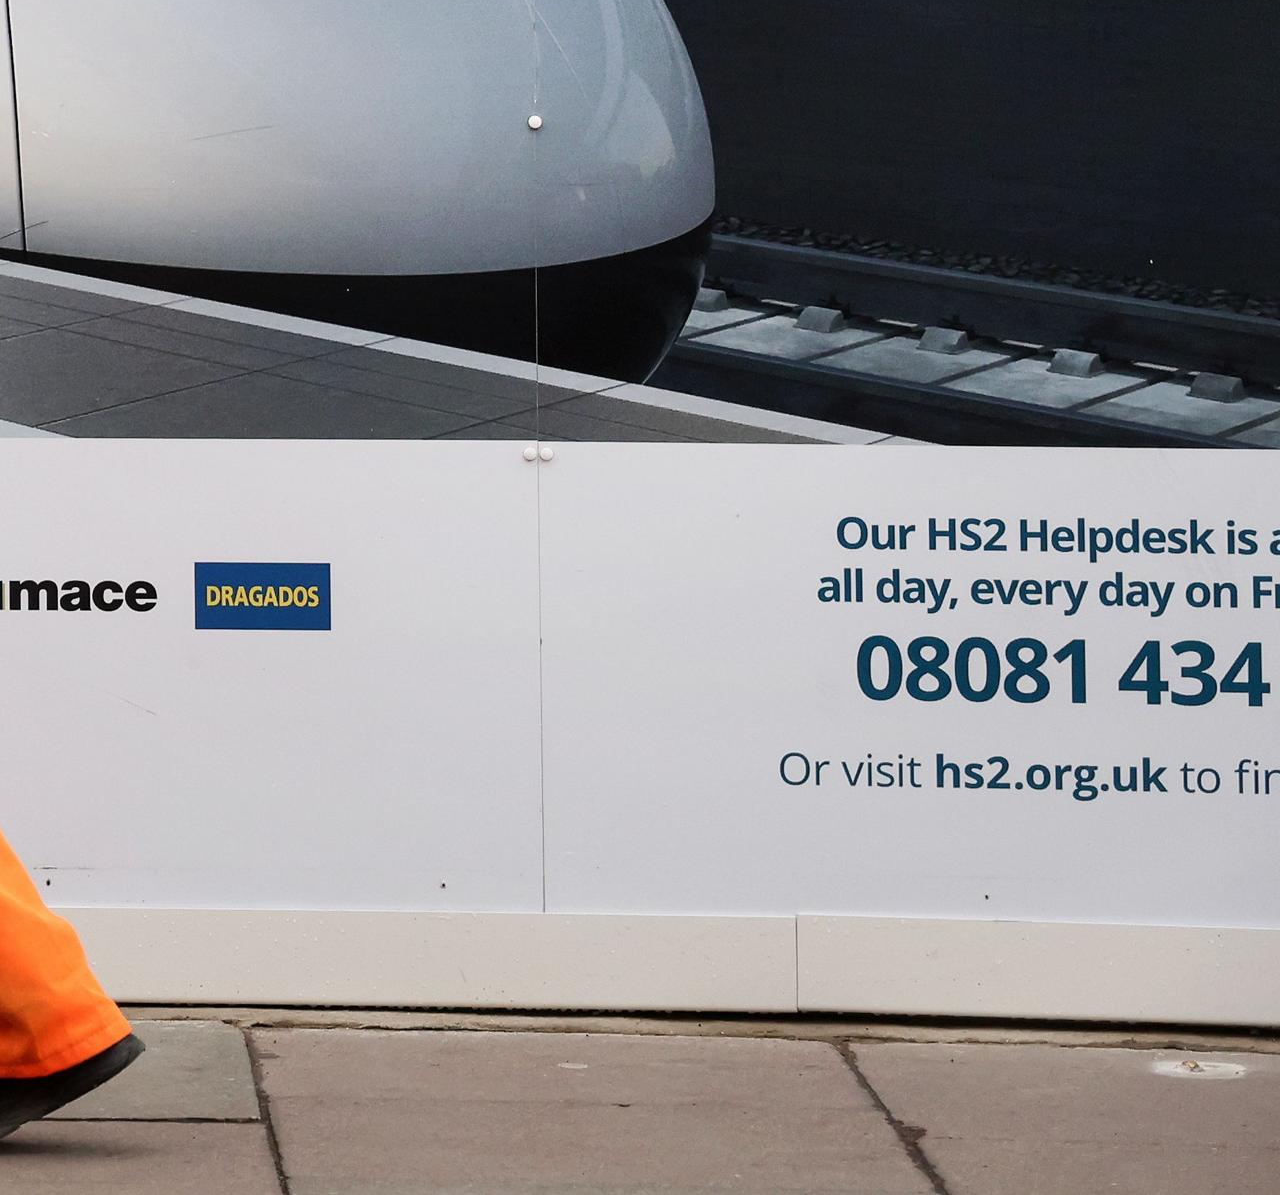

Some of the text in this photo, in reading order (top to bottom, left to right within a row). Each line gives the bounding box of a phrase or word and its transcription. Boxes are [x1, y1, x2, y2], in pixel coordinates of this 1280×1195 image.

[837, 516, 915, 550] Our
[928, 518, 1007, 551] HS2
[1020, 518, 1216, 563] Helpdesk
[1227, 520, 1258, 555] is
[9, 580, 158, 612] mace
[206, 585, 320, 608] DRAGADOS
[818, 568, 863, 603] all
[876, 569, 958, 614] day,
[970, 578, 1088, 616] every
[1099, 572, 1175, 617] day
[1186, 582, 1238, 609] on
[857, 635, 1271, 707] 08081 434
[779, 752, 830, 786] Or
[841, 754, 922, 788] visit
[936, 753, 1168, 801] hs2.org.uk
[1180, 763, 1220, 794] to
